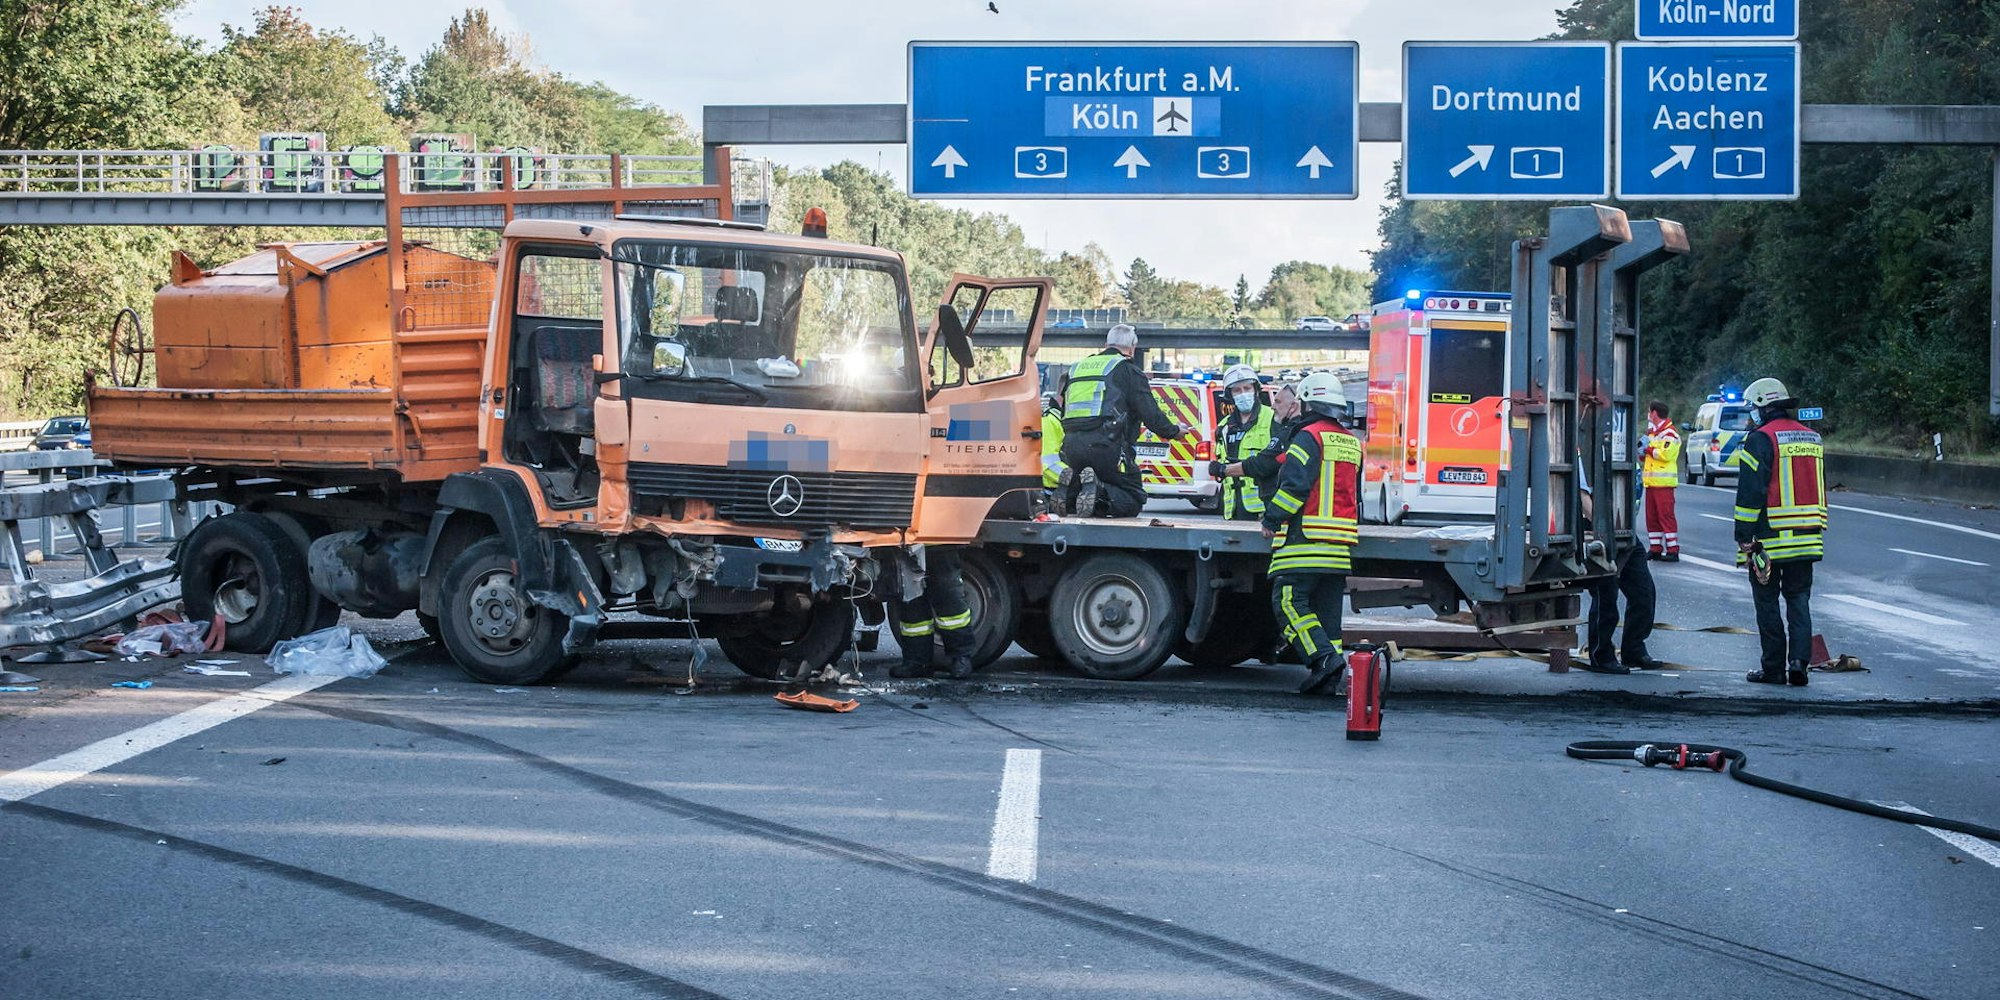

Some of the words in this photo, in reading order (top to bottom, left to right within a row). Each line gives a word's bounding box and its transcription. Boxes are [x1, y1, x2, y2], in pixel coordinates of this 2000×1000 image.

[1659, 0, 1775, 24] Köln-Nord
[1026, 66, 1167, 92] Frankfurt
[1182, 66, 1240, 92] a.M.
[1648, 66, 1768, 92] Koblenz
[1432, 85, 1580, 111] Dortmund
[1072, 104, 1138, 130] Köln
[1653, 105, 1763, 130] Aachen
[1035, 153, 1047, 171] 3
[1218, 153, 1230, 172] 3
[1532, 153, 1540, 172] 1
[1735, 154, 1743, 172] 1
[946, 445, 1018, 453] TIEFBAU
[1443, 472, 1457, 480] LEV
